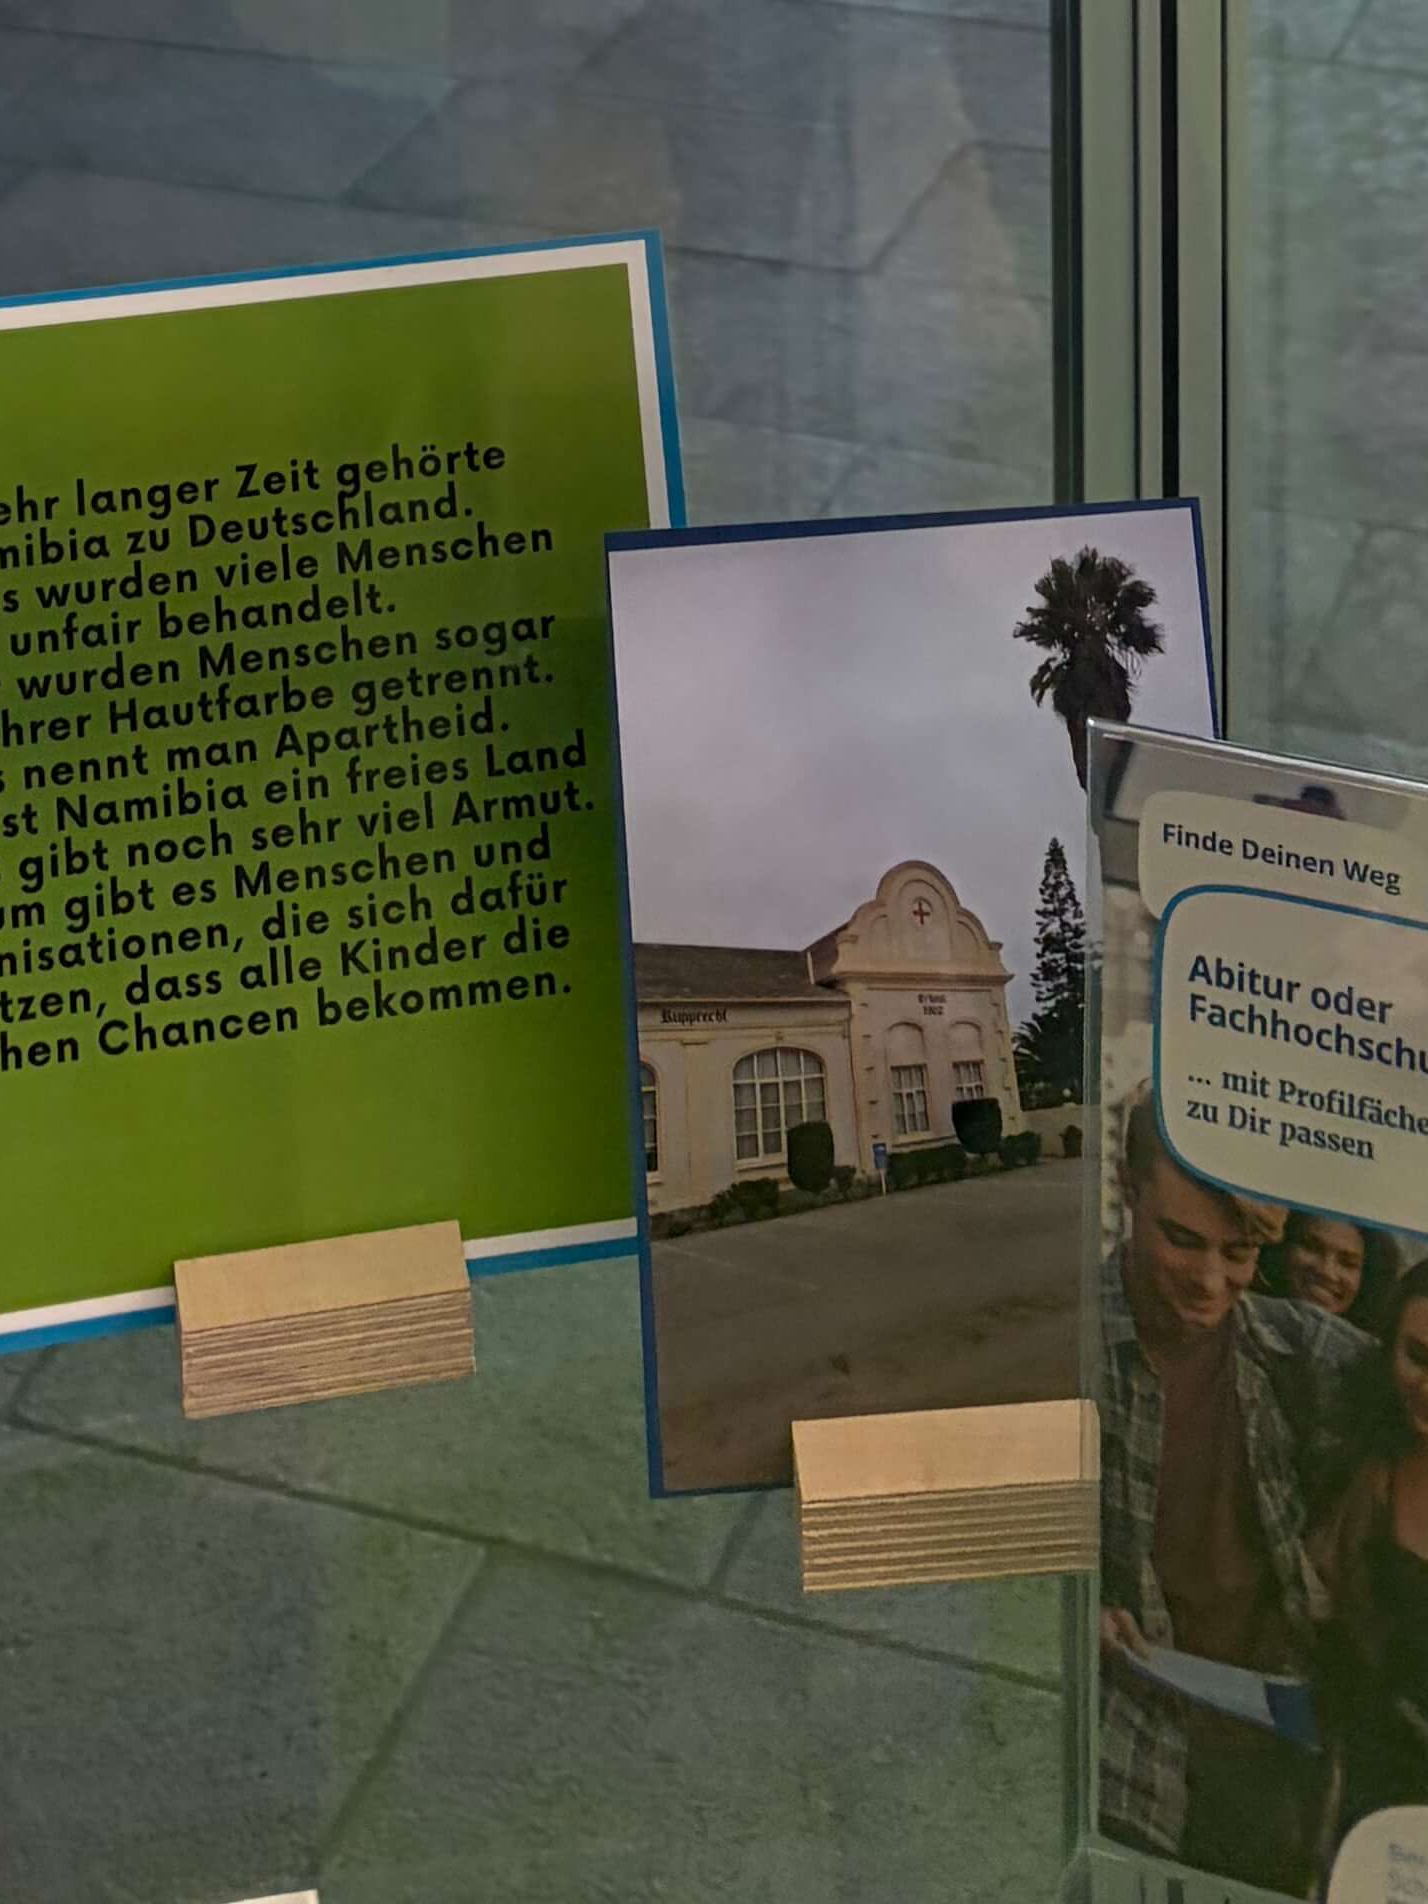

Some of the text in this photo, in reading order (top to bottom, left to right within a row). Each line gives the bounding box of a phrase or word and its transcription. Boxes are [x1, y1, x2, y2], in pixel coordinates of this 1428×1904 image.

[76, 478, 220, 520] langer
[236, 459, 320, 499] Zeit
[336, 441, 505, 502] gehörte
[126, 528, 170, 556] zu
[188, 481, 472, 548] Deutschland.
[35, 560, 198, 609] wurden
[214, 542, 318, 588] viele
[336, 521, 552, 575] Menschen
[10, 578, 395, 656] unfair behandelt.
[16, 650, 180, 701] wurden
[199, 625, 417, 679] Menschen
[435, 616, 555, 657] sogar
[109, 677, 334, 735] Hautfarbe
[351, 655, 553, 717] getrennt.
[24, 744, 148, 790] nennt
[167, 739, 257, 772] man
[275, 697, 508, 768] Apartheid.
[56, 776, 248, 832] Namibia
[264, 766, 329, 805] ein
[346, 752, 468, 795] freies
[486, 728, 586, 777] Land
[19, 838, 109, 894] gibt
[127, 821, 233, 868] noch
[252, 811, 342, 851] sehr
[356, 796, 434, 838] viel
[452, 781, 594, 835] Armut.
[65, 876, 155, 933] gibt
[172, 879, 217, 907] es
[234, 842, 455, 899] Menschen
[474, 822, 551, 868] und
[1163, 822, 1402, 896] Finde Deinen Weg
[261, 902, 329, 941] die
[348, 886, 432, 930] sich
[450, 873, 567, 916] dafür
[125, 967, 222, 1006] dass
[240, 948, 322, 990] alle
[340, 929, 486, 976] Kinder
[504, 917, 570, 955] die
[1188, 954, 1395, 1025] Abitur oder
[98, 1006, 298, 1056] Chancen
[317, 972, 571, 1026] bekommen.
[1221, 1070, 1271, 1099] mit
[1186, 1101, 1375, 1161] zu Dir passen
